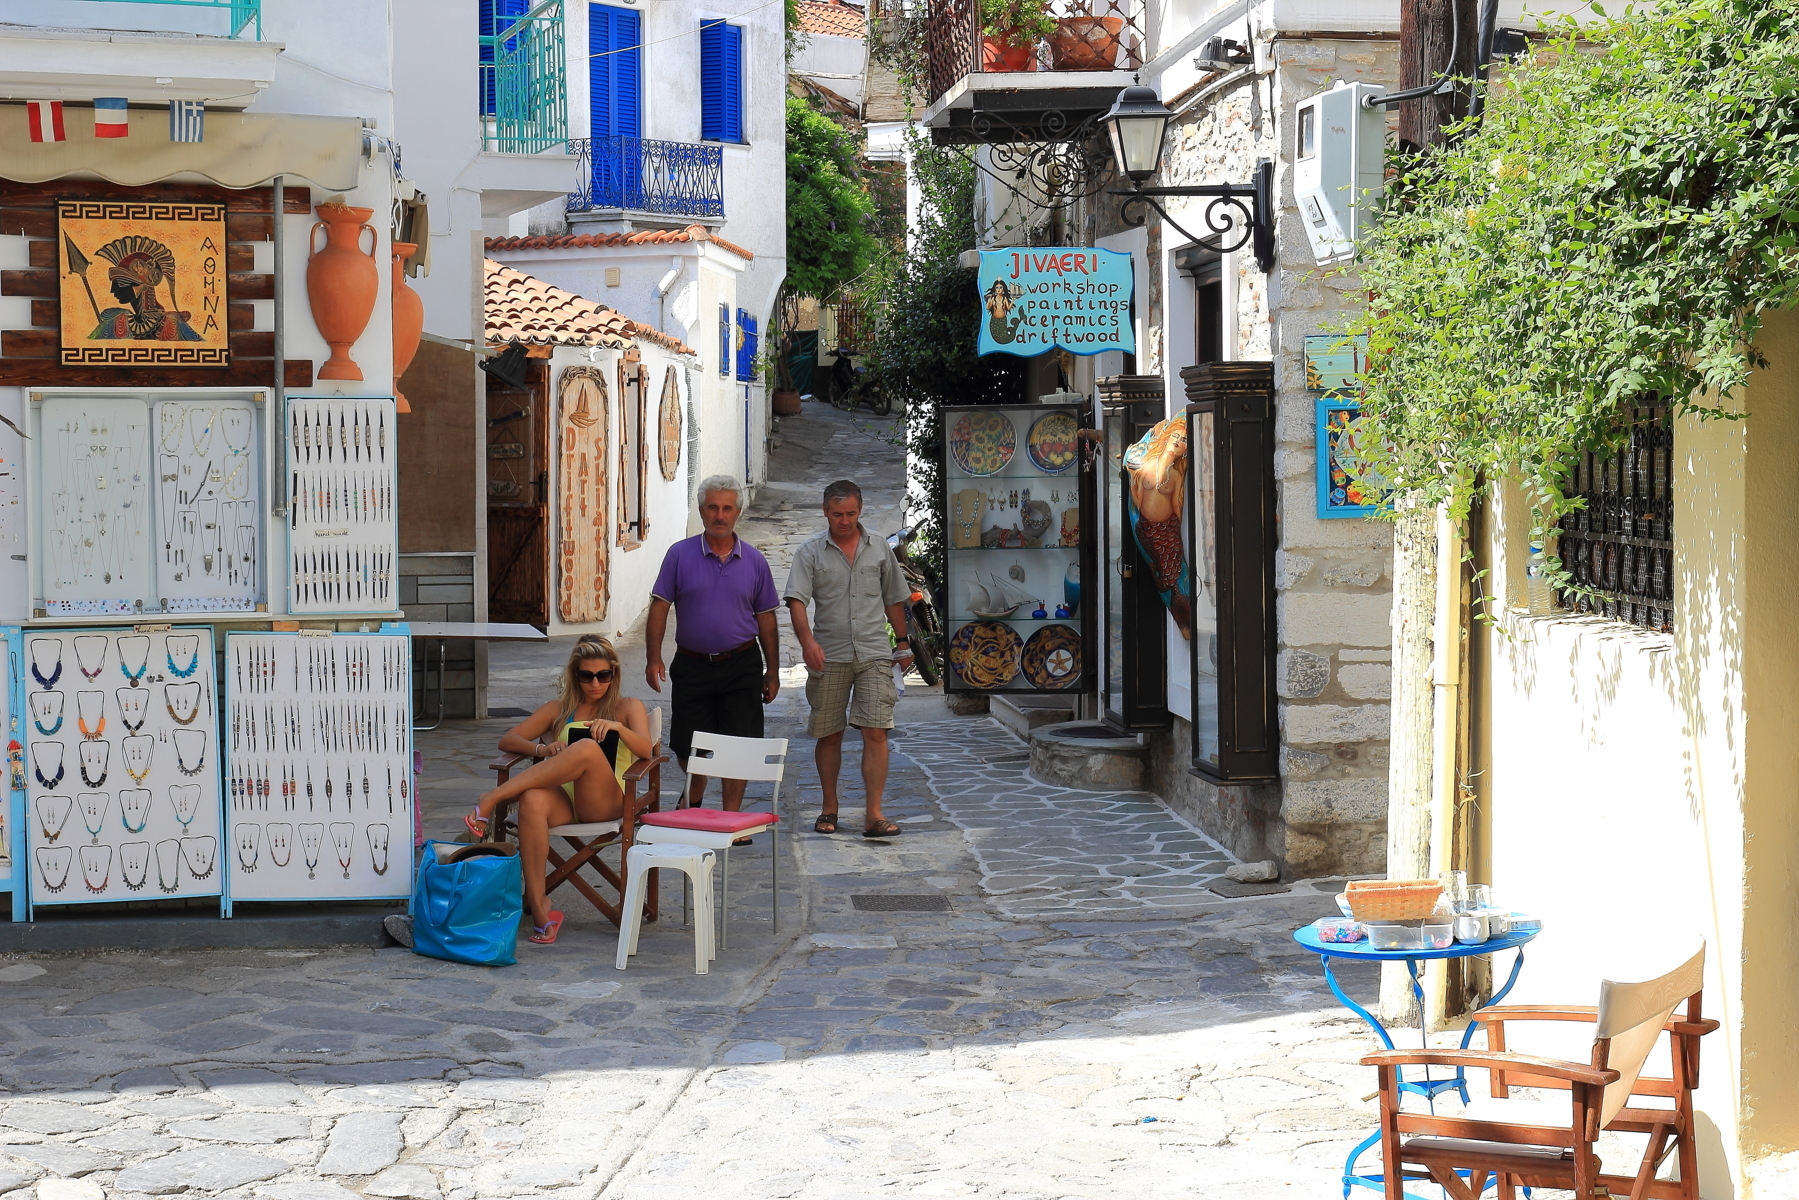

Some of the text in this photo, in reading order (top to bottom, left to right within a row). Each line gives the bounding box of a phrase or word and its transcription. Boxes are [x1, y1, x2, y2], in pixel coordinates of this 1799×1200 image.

[1010, 252, 1098, 280] JIVAERI
[200, 236, 219, 335] ΑΘΗΝΑ
[1026, 278, 1119, 298] workshop
[1027, 295, 1129, 315] paintings
[1028, 312, 1120, 328] ceramics
[1015, 327, 1121, 346] driftwood
[578, 452, 589, 518] Art
[592, 437, 605, 611] Skiathos
